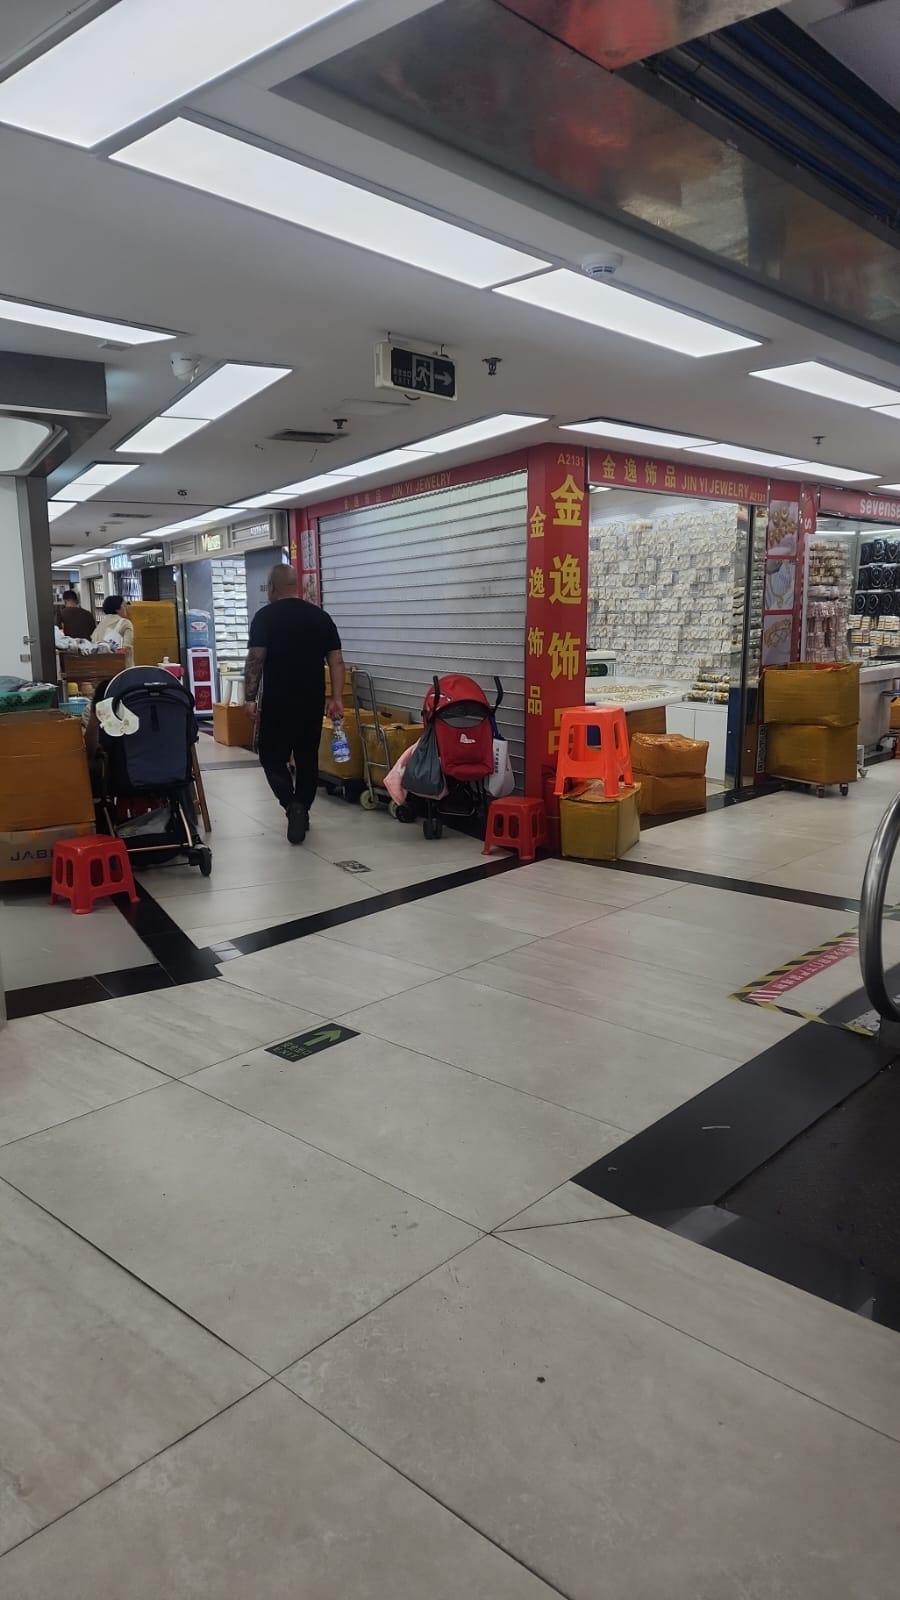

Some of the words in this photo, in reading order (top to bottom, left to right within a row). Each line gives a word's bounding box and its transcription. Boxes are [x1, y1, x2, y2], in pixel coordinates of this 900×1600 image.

[557, 453, 584, 467] A2131
[602, 454, 676, 488] 金逸饰品
[415, 471, 451, 492] JEWELRY
[681, 475, 697, 492] JIN
[699, 477, 708, 493] YI
[709, 479, 750, 499] JEWELRY
[528, 505, 546, 715] 金逸饰品
